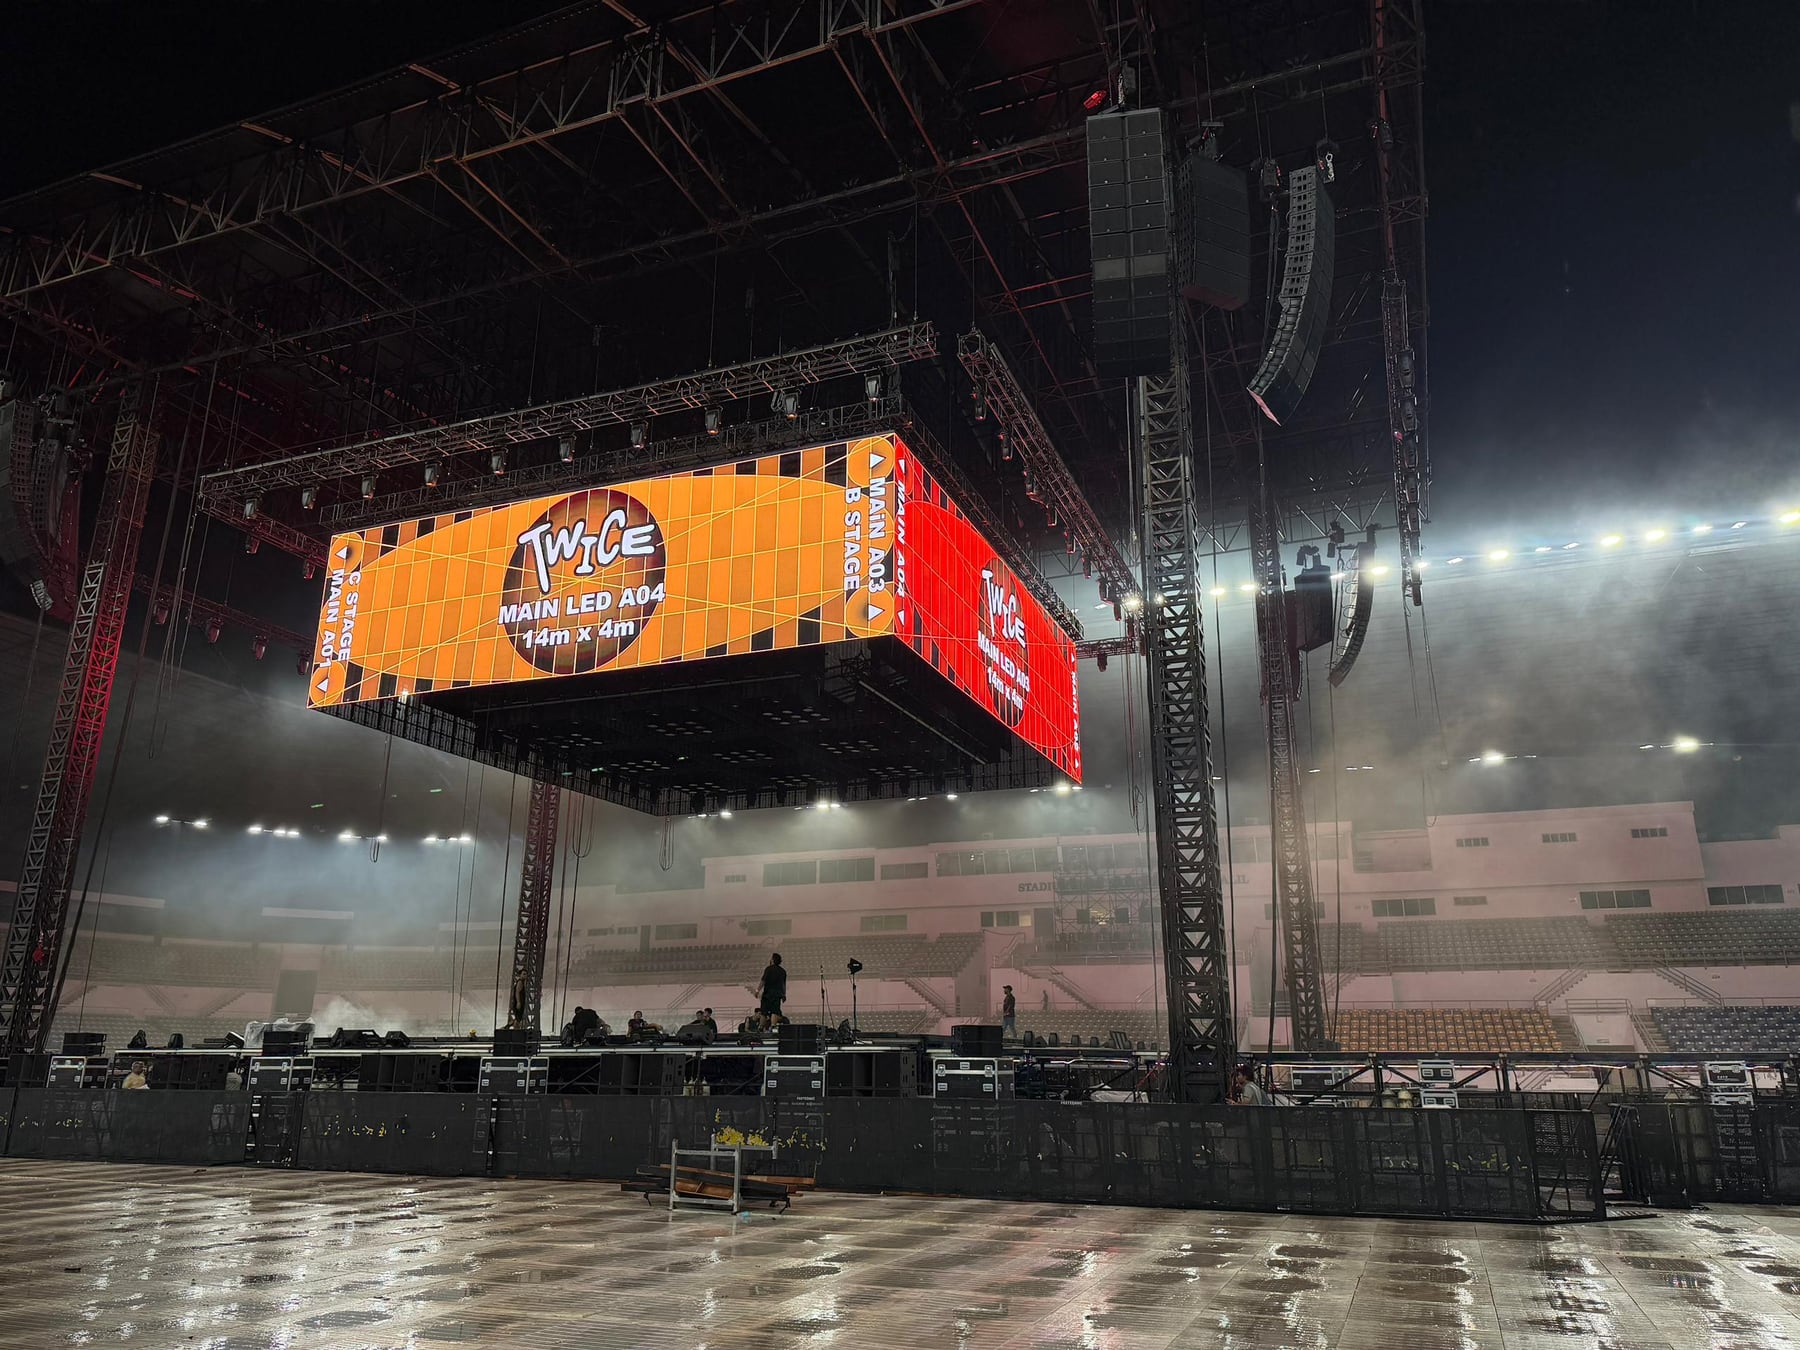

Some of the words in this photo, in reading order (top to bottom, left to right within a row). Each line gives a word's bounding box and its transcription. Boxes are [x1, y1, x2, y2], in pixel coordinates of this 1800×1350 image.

[845, 487, 861, 504] B
[897, 481, 906, 545] MAIN
[518, 509, 655, 594] TWICE
[843, 511, 861, 590] STAGE
[868, 548, 885, 593] A03
[327, 569, 345, 623] MAIN
[349, 571, 362, 586] C
[338, 592, 359, 661] STAGE
[498, 602, 559, 625] MAIN
[566, 591, 612, 615] LED
[618, 582, 666, 608] A04
[981, 569, 1026, 648] TWICE
[320, 631, 336, 668] A01
[522, 626, 570, 649] 14m
[576, 628, 592, 643] x
[598, 618, 635, 639] 4m
[978, 630, 999, 664] MAIN
[1000, 652, 1015, 679] LED
